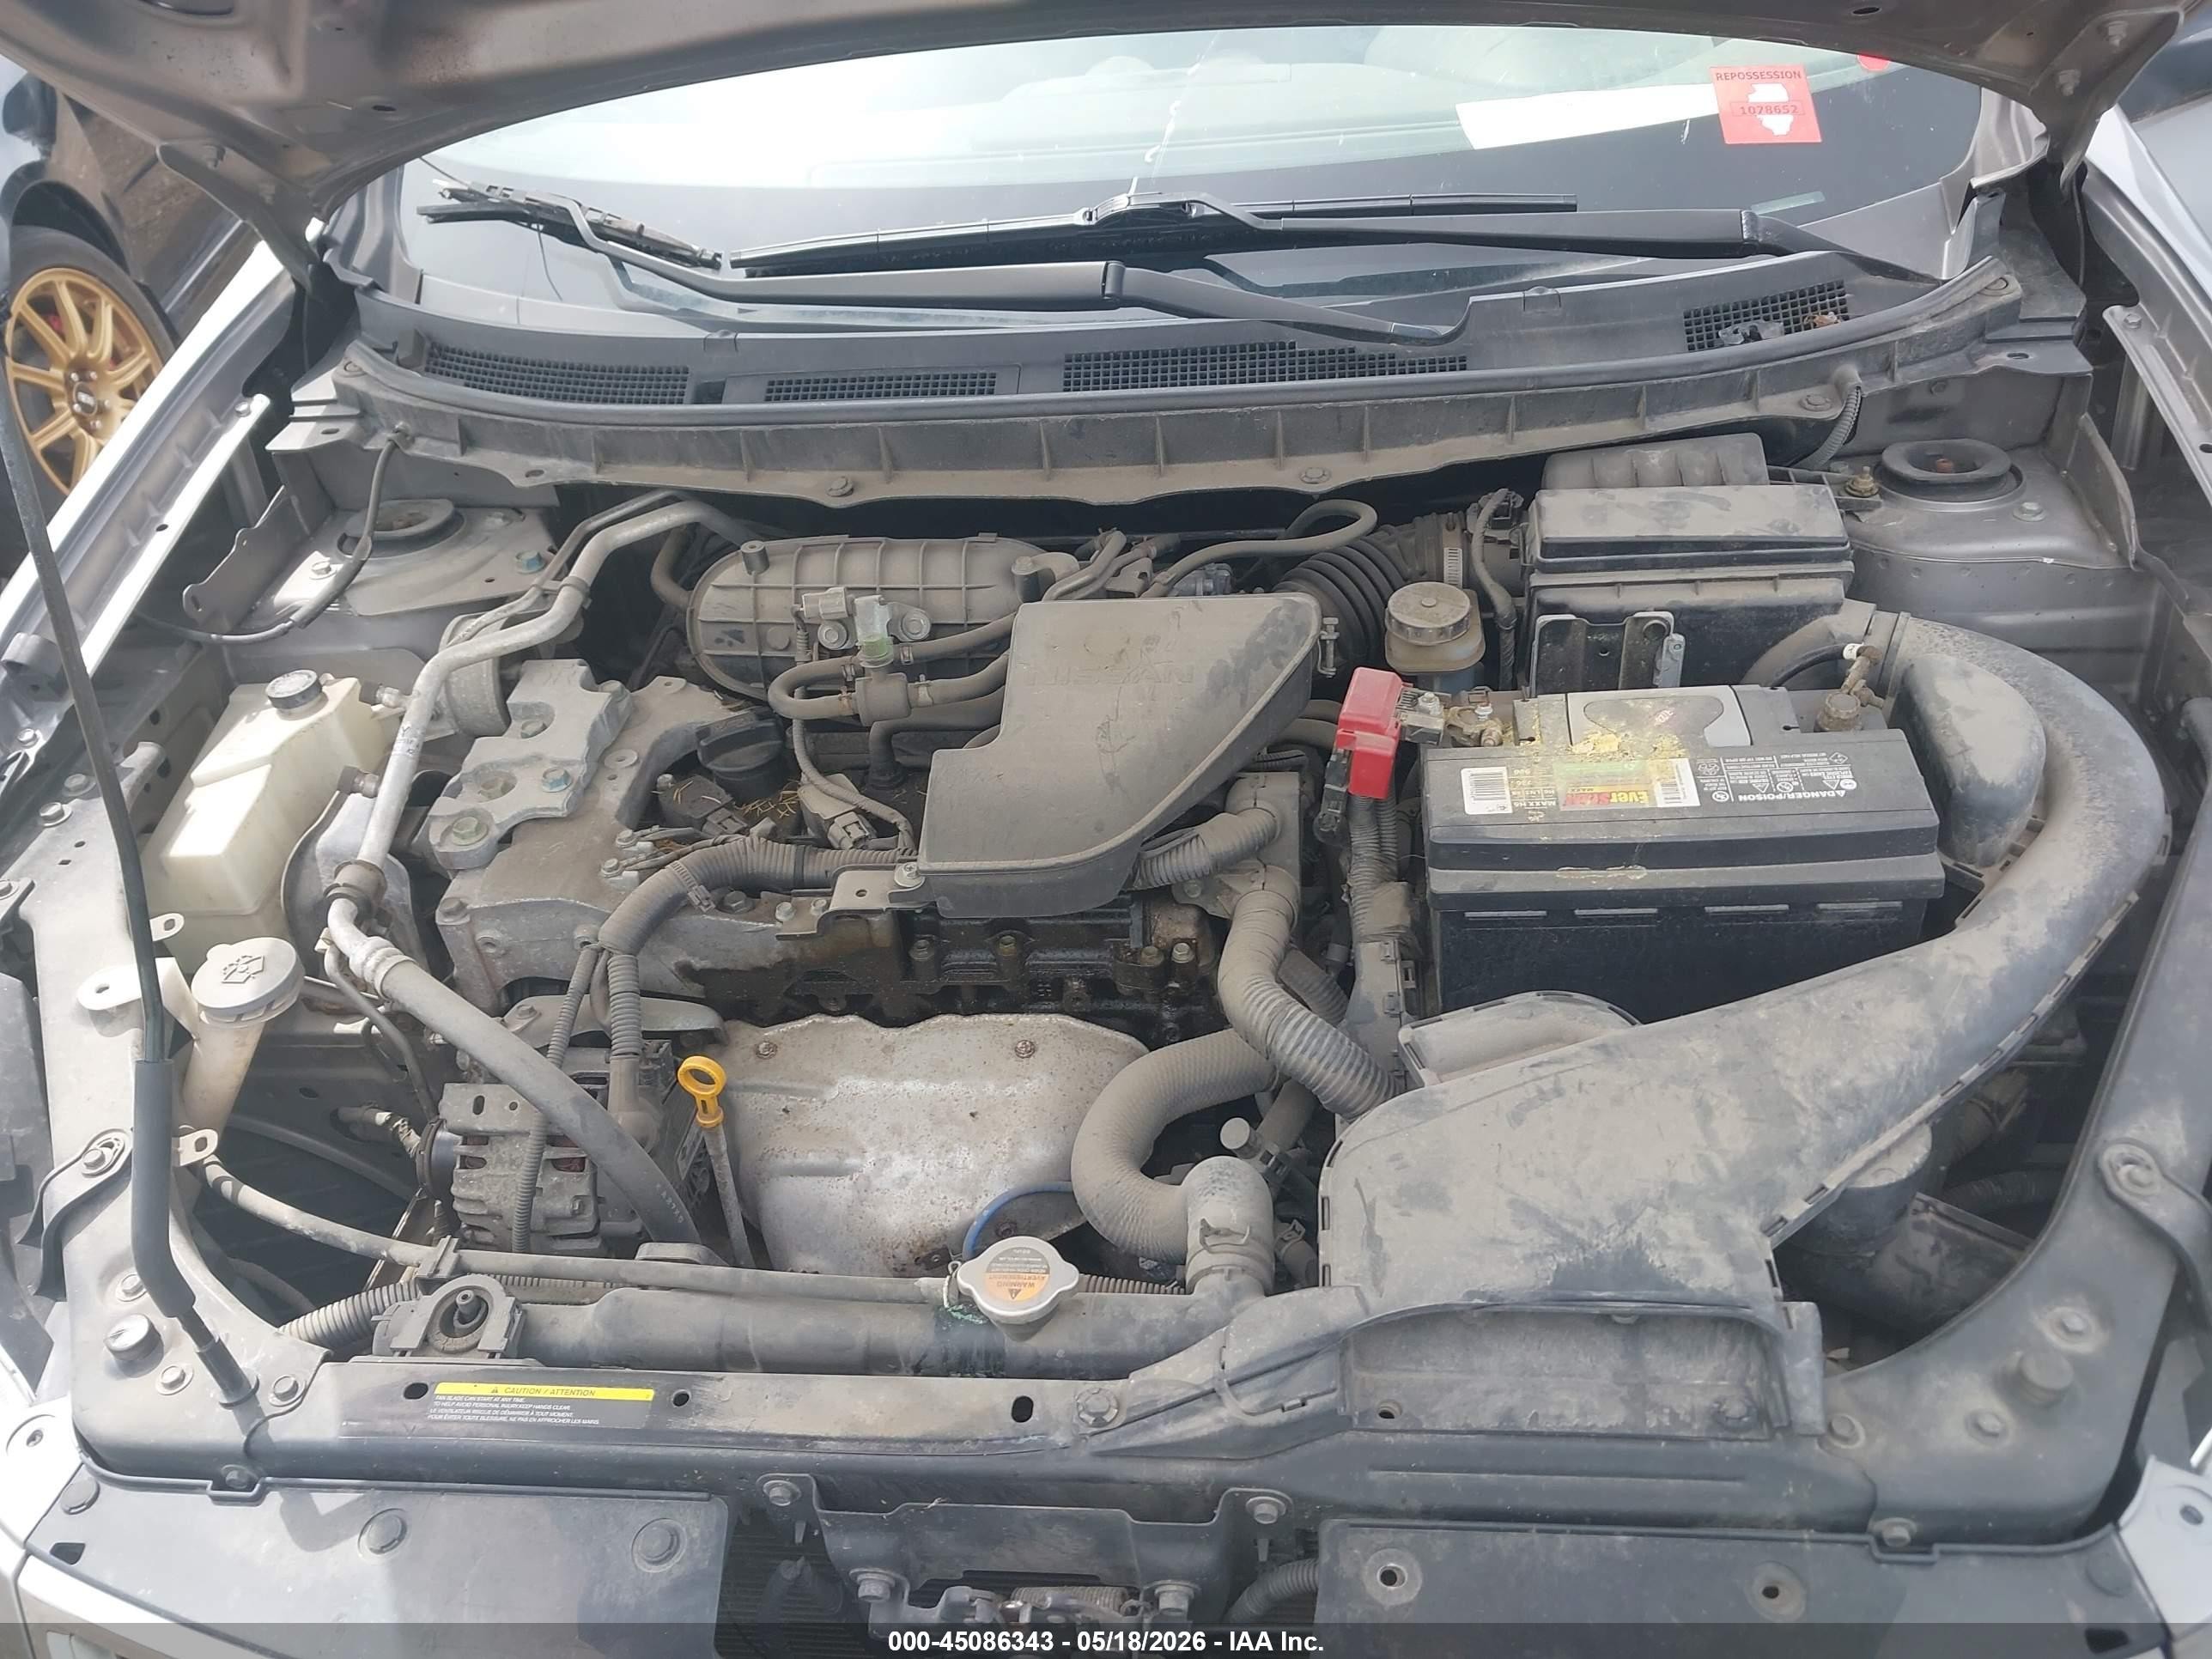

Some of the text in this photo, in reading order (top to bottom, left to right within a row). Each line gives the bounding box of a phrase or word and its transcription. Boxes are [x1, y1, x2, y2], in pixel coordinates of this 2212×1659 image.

[1716, 70, 1802, 81] REPOSSESSION
[1741, 105, 1799, 115] 1078652
[1565, 790, 1650, 806] EverSt
[1738, 790, 1836, 802] DANGER/POISON
[550, 1388, 596, 1396] ATTENTION
